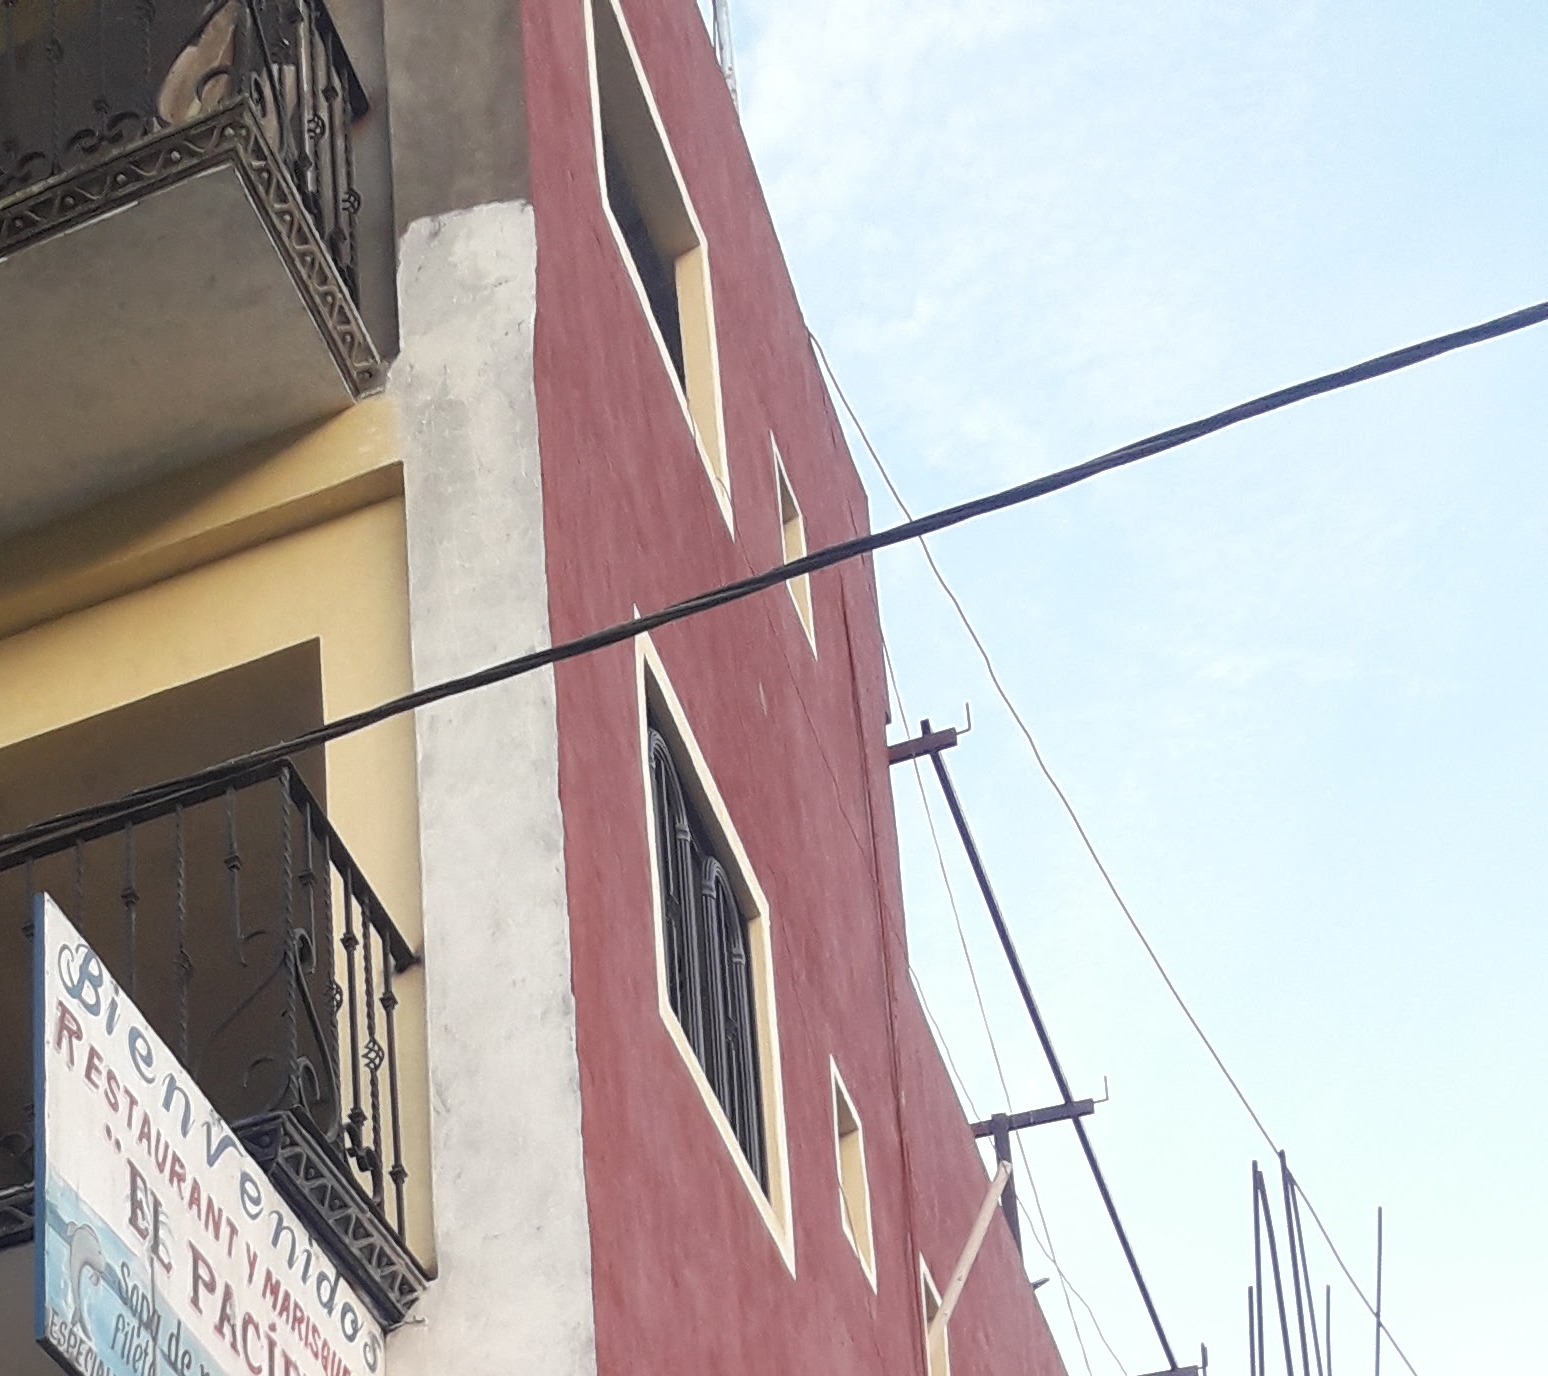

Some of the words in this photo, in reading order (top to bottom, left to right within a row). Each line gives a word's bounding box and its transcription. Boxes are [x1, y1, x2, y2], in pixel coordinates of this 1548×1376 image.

[54, 999, 239, 1258] RESTAURANT
[246, 1241, 258, 1286] Y
[58, 944, 381, 1373] Bienvenidos
